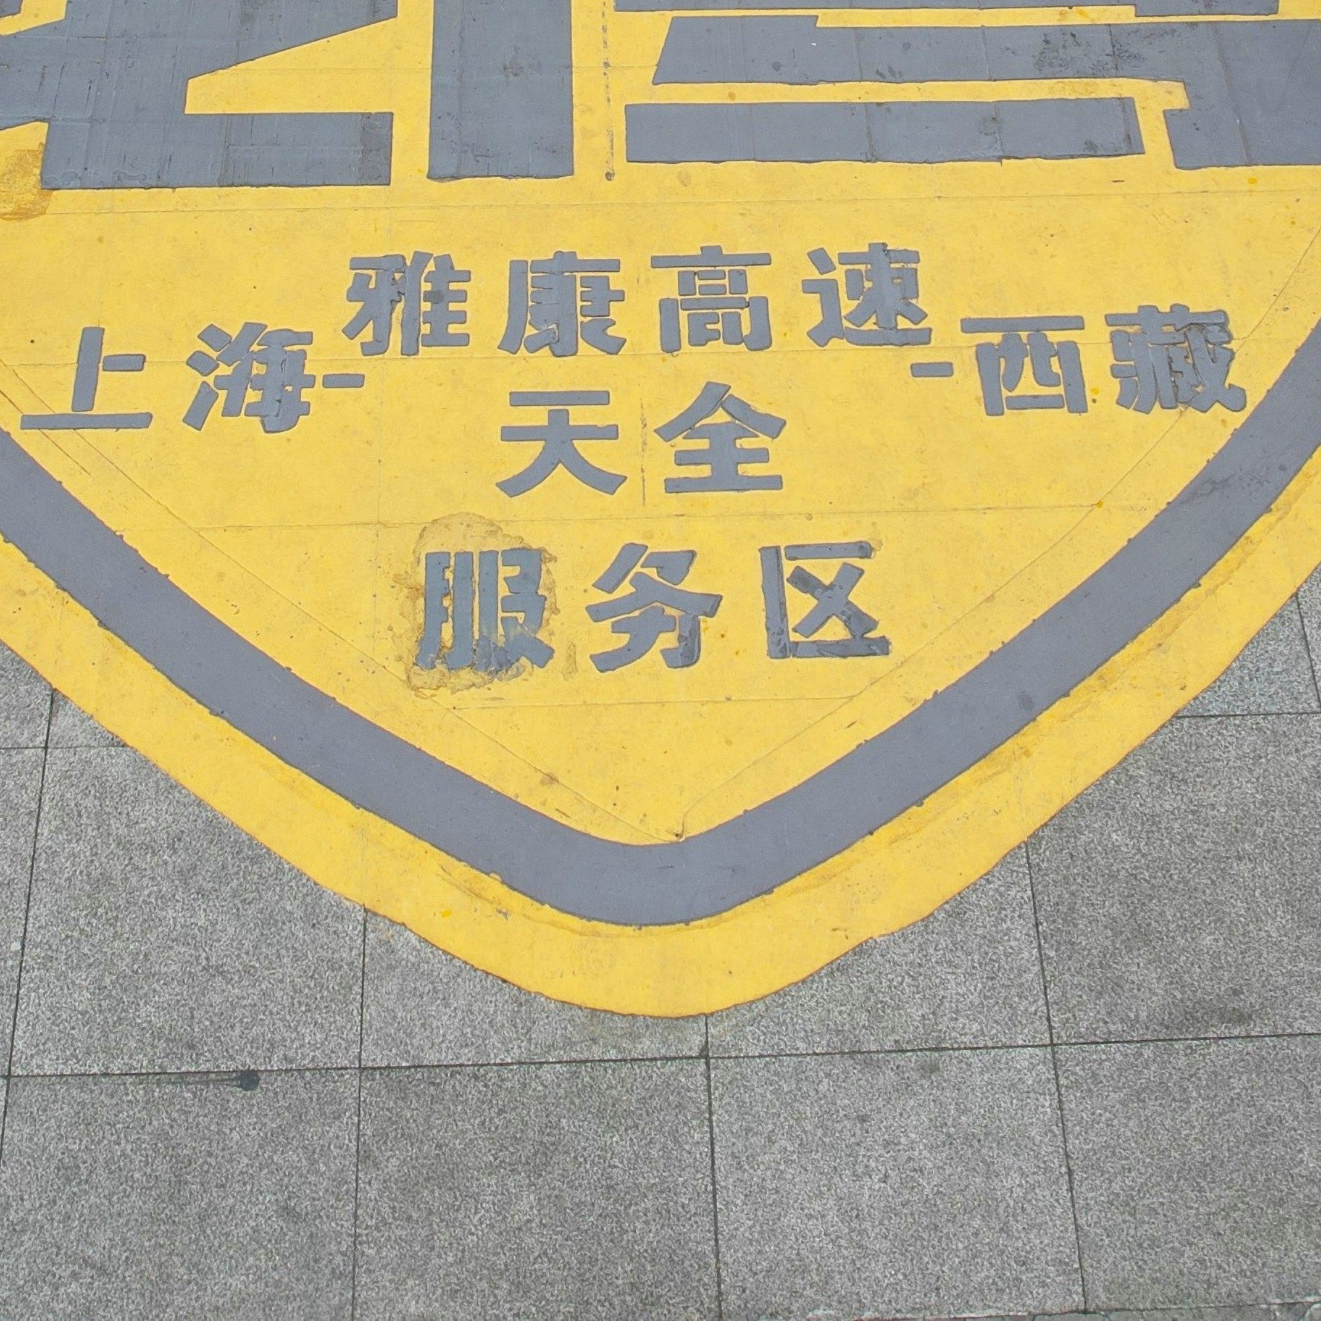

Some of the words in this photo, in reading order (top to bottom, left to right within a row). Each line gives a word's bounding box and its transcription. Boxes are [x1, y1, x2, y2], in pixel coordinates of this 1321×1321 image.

[343, 241, 933, 358] 雅康高速
[498, 381, 786, 498] 天全
[415, 540, 892, 675] 服务区
